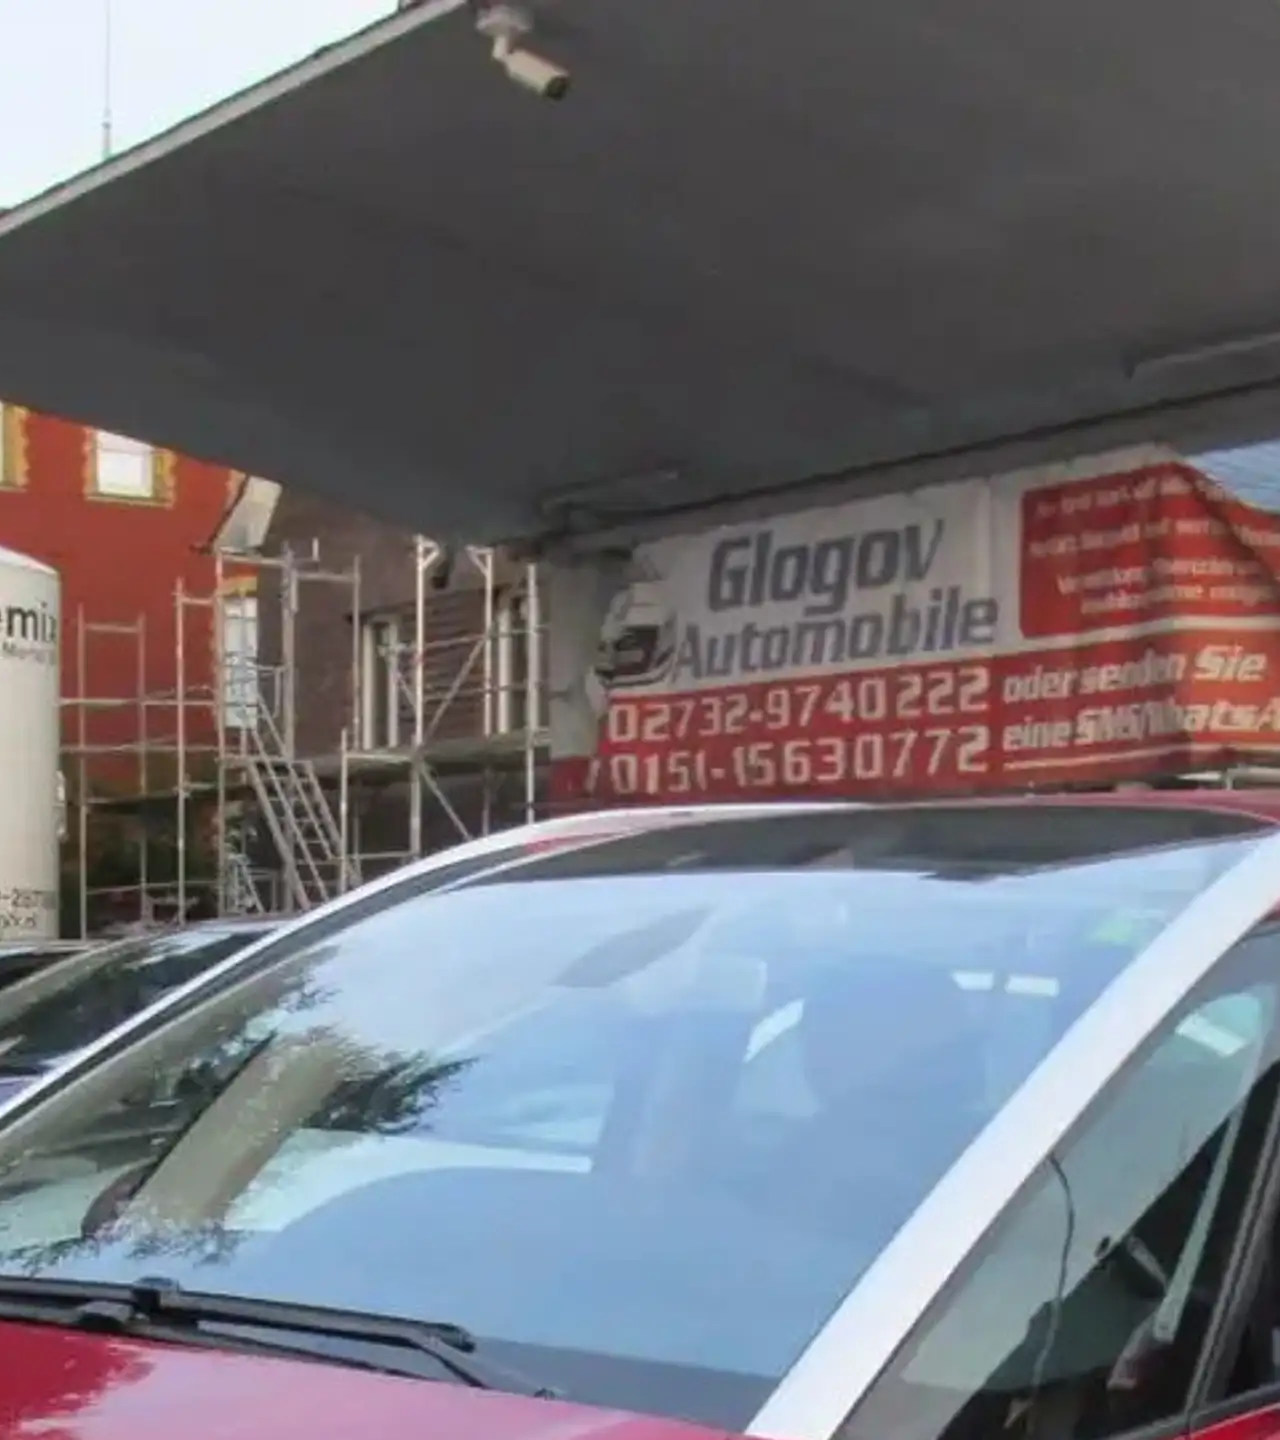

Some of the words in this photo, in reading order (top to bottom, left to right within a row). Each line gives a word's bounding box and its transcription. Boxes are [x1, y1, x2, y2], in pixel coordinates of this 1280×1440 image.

[707, 518, 946, 617] Glogov
[673, 586, 999, 681] Automobile
[608, 666, 991, 743] 02732-9740222
[1002, 664, 1077, 702] oder
[1079, 648, 1186, 695] senden
[1193, 644, 1268, 682] Sie
[1002, 715, 1072, 752] eine
